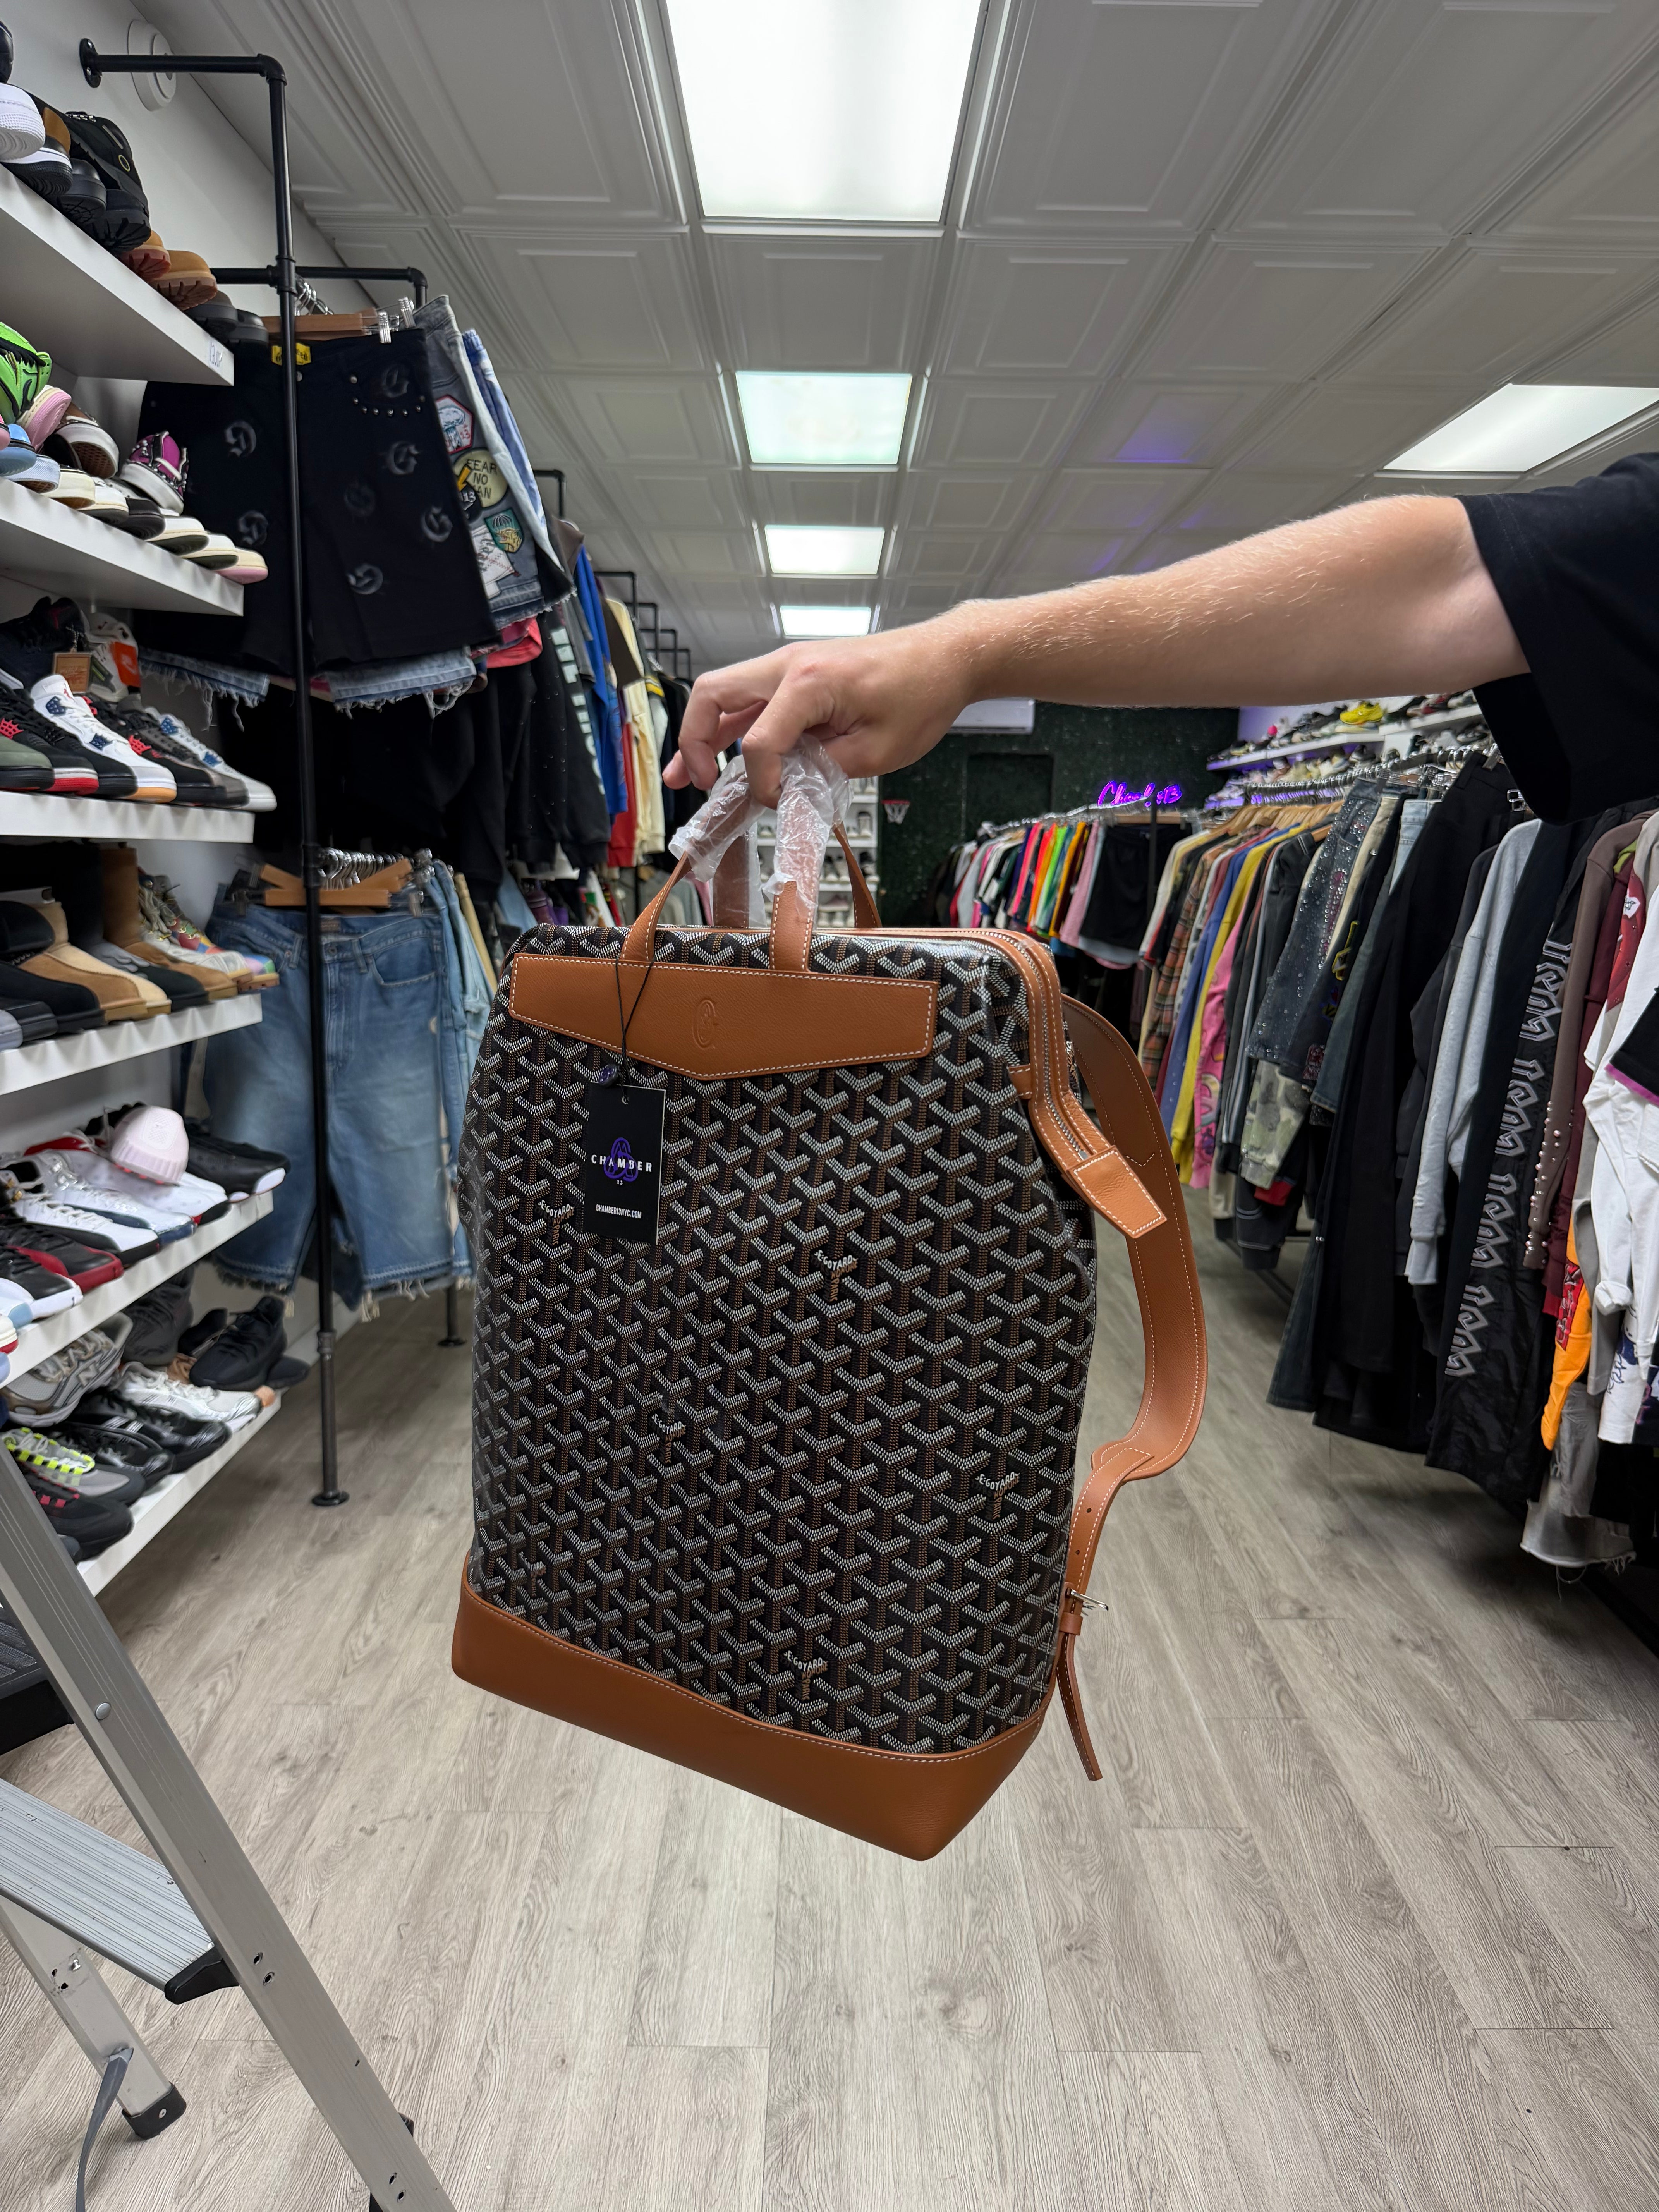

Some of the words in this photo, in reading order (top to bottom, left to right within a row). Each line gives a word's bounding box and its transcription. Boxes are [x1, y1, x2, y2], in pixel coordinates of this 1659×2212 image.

[467, 459, 498, 475] FEAR
[473, 472, 488, 485] NO
[474, 485, 492, 499] AN
[591, 1154, 653, 1173] CHAMBER
[596, 1204, 642, 1219] CHAMBER13NYC.COM
